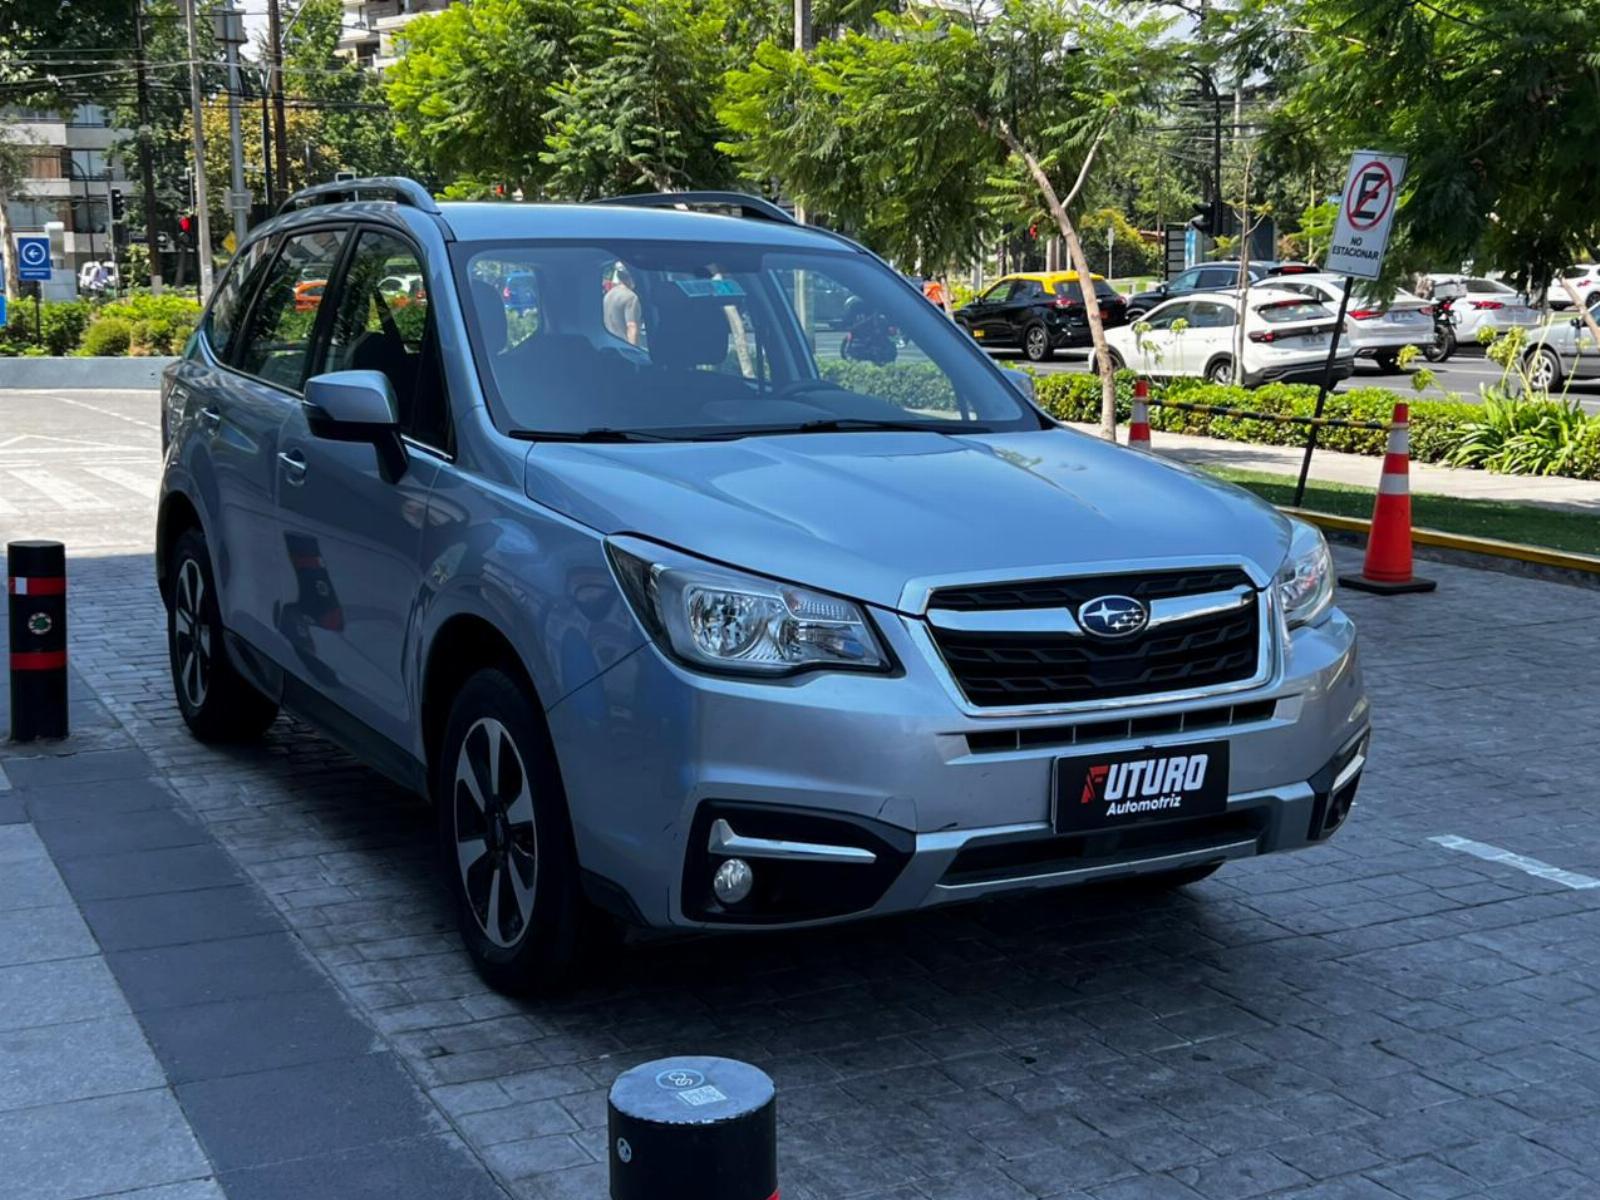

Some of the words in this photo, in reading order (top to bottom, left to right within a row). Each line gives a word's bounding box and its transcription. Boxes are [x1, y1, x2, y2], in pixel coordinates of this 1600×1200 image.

[1350, 236, 1363, 246] NO
[1332, 245, 1379, 260] ESTACIONAR
[1081, 754, 1208, 803] FUTURO
[1106, 793, 1182, 816] Automotriz
